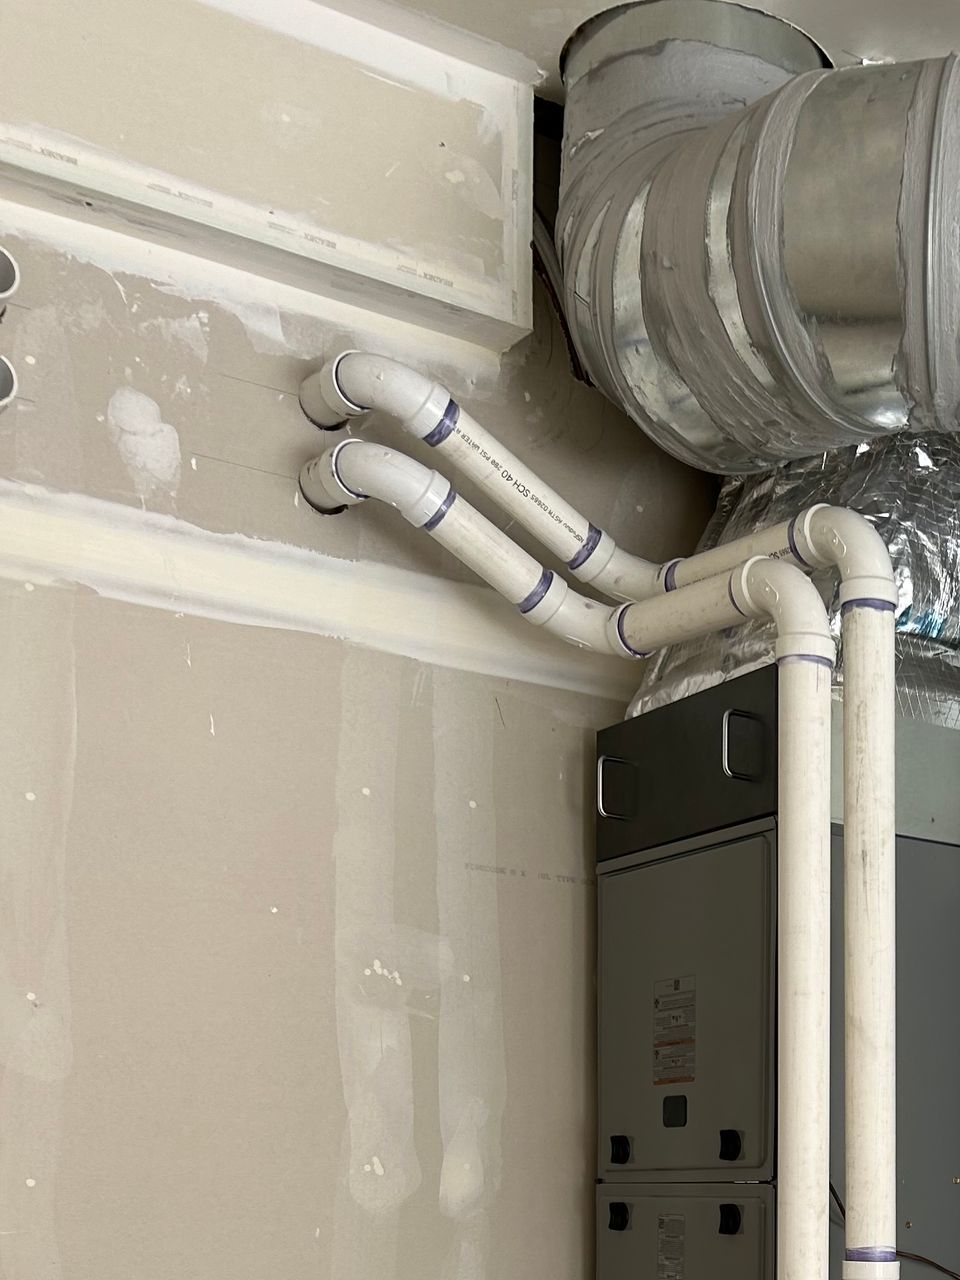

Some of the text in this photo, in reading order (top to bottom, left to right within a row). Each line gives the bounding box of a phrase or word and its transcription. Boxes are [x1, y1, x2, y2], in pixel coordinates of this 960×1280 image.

[460, 433, 480, 452] WATER
[479, 449, 492, 461] PSI
[501, 469, 514, 482] 40
[512, 479, 531, 498] SCH
[547, 509, 564, 525] ASTM
